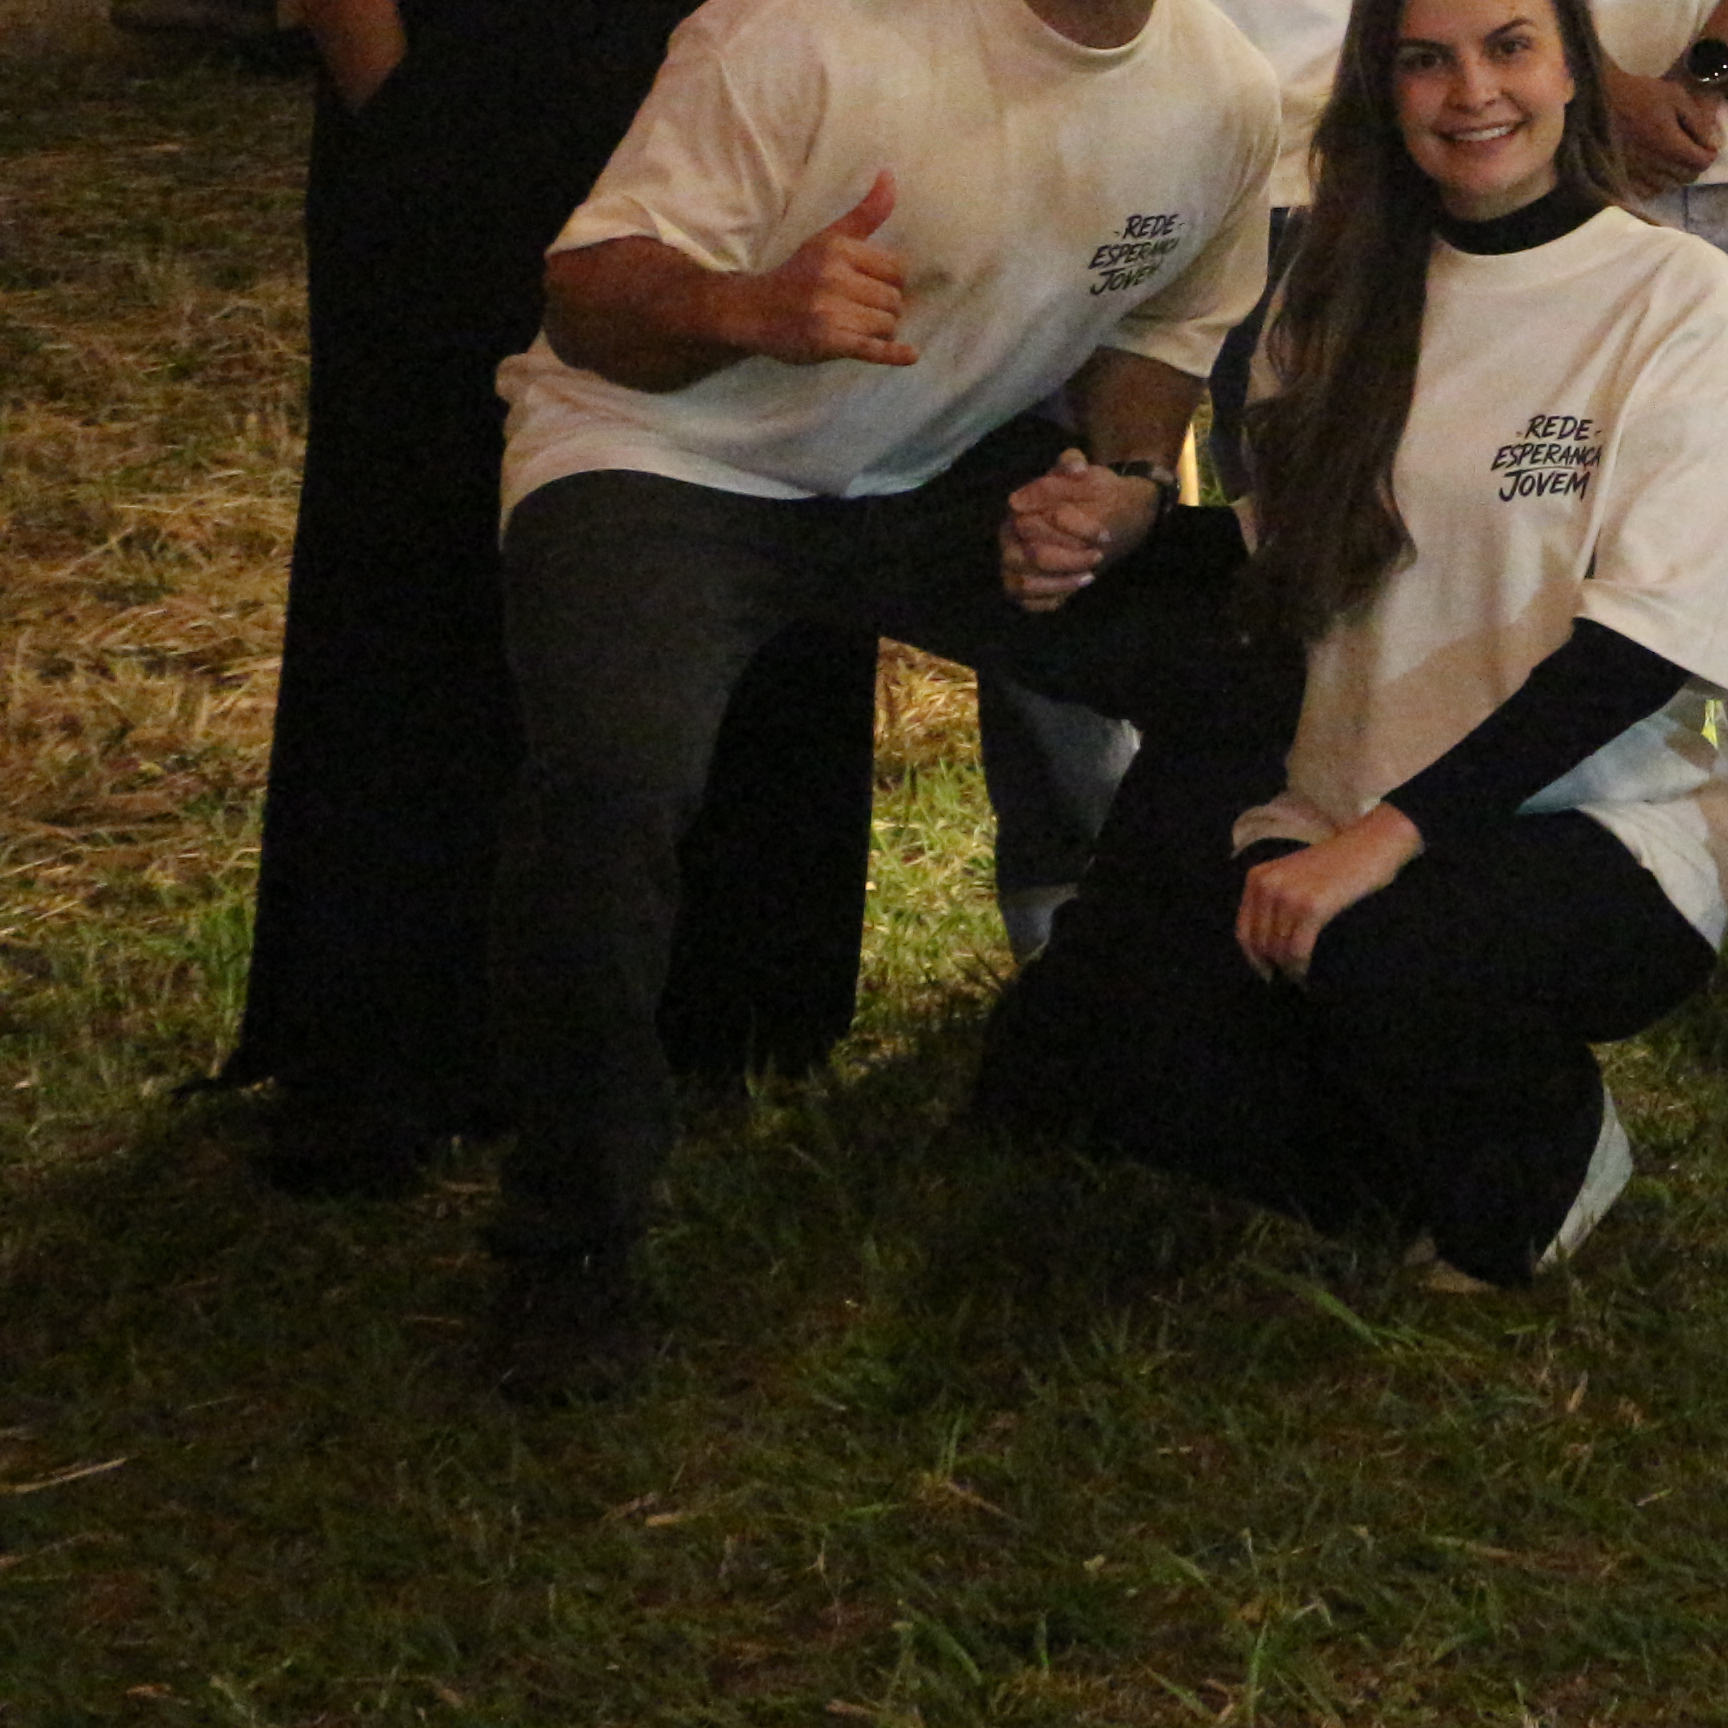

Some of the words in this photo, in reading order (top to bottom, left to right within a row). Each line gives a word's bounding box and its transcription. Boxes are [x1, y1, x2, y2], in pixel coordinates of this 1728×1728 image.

[1122, 214, 1179, 239] REDE
[1524, 414, 1594, 441] REDE
[1490, 442, 1602, 471] ESPERANÇA
[1498, 469, 1591, 502] JOVEM
